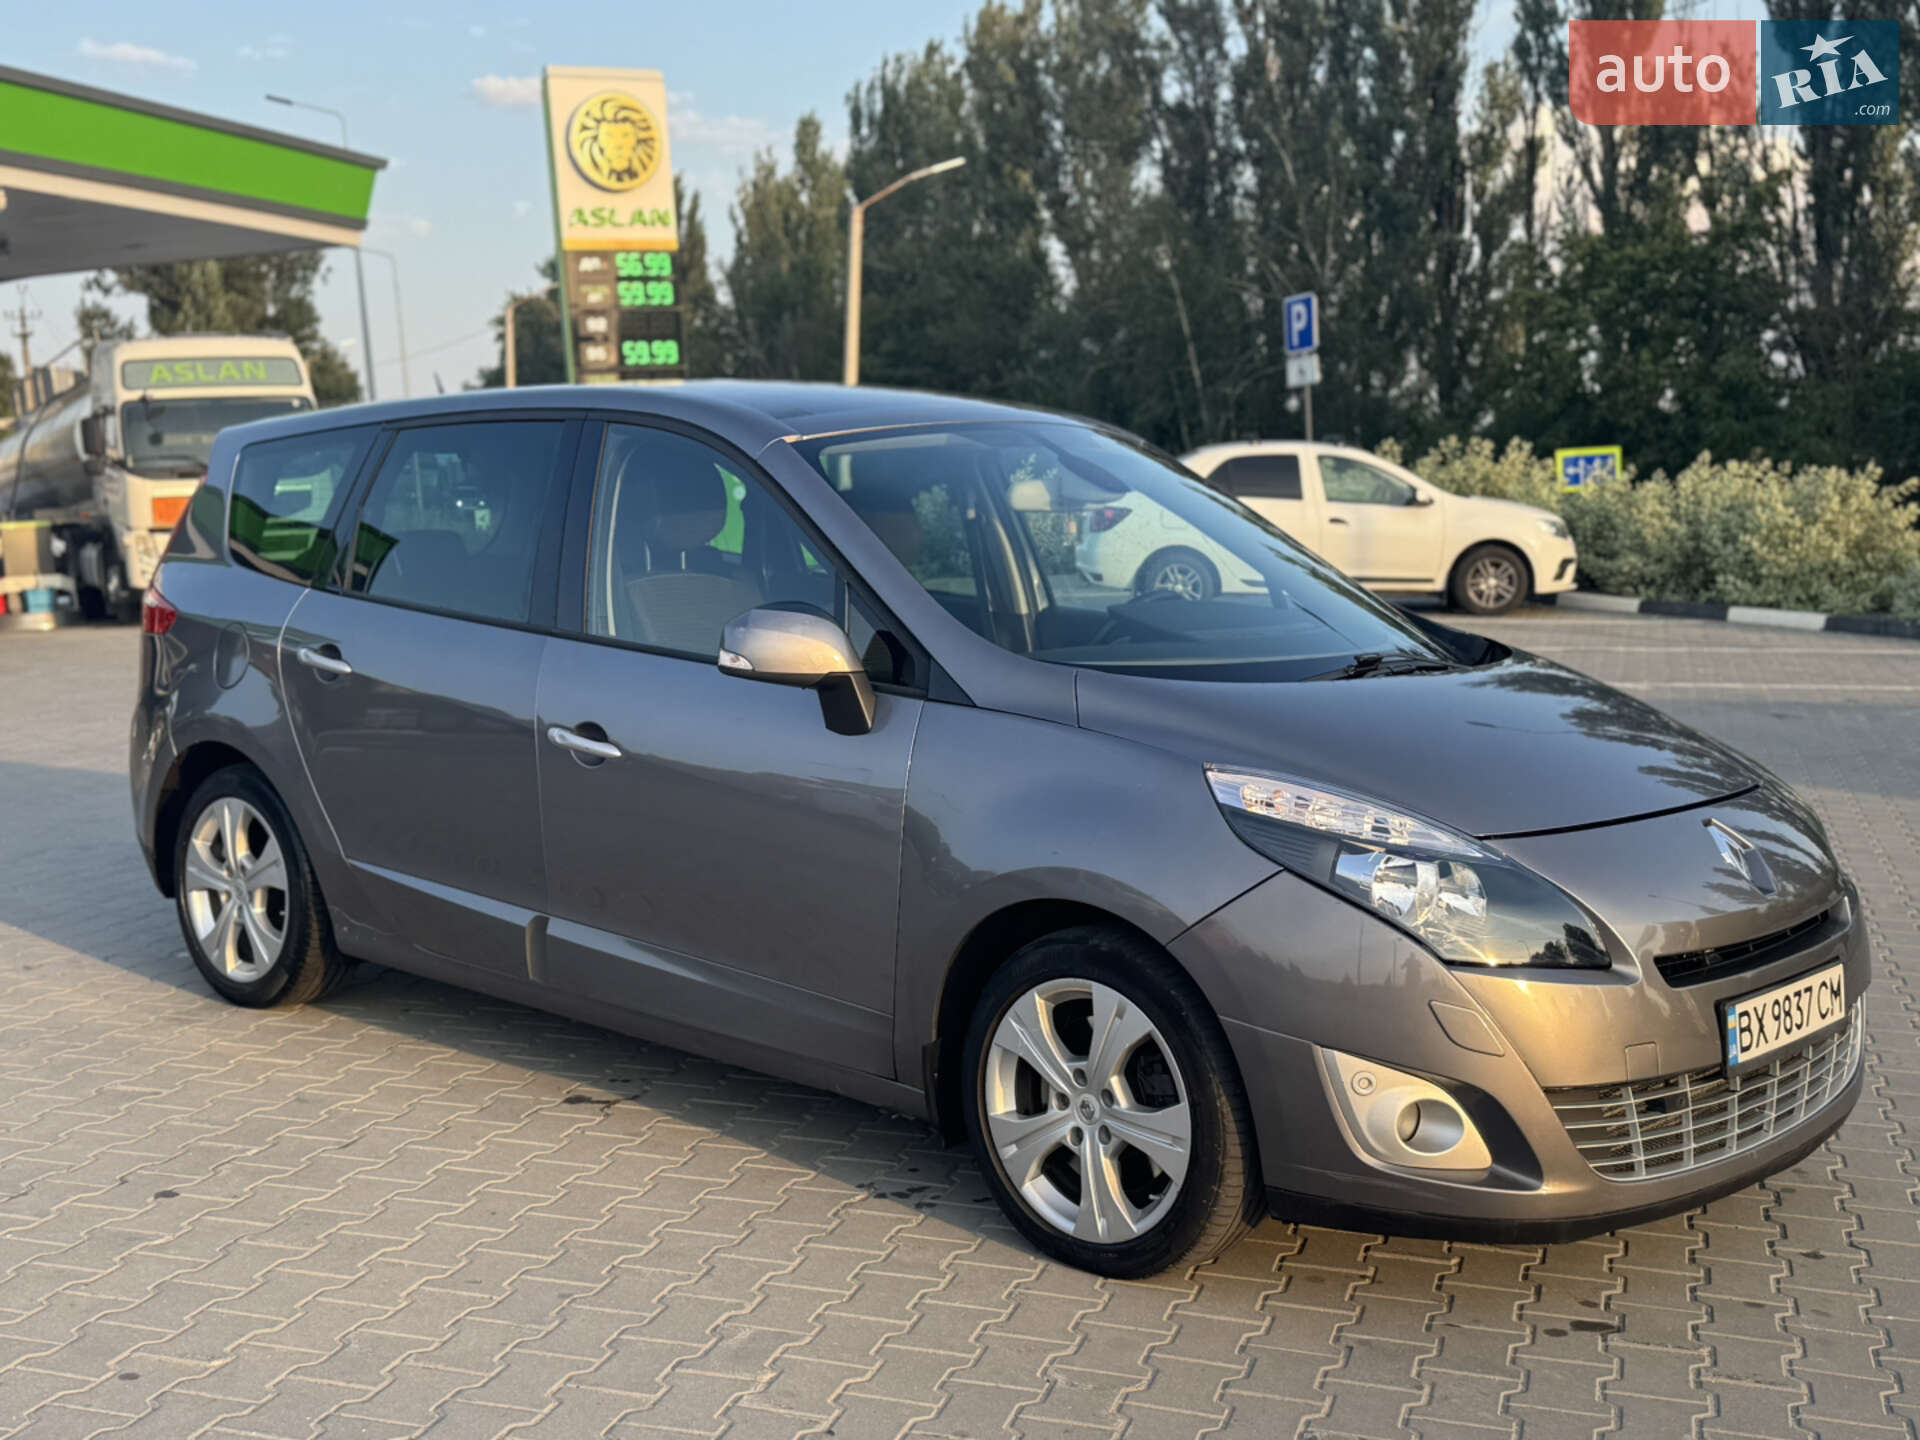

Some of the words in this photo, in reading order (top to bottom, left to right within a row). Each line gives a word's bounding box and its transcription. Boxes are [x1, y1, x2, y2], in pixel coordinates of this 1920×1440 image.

[569, 206, 672, 228] ASLAN
[1291, 302, 1309, 347] P
[150, 360, 267, 384] ASLAN
[1738, 1003, 1769, 1055] BX
[1771, 985, 1813, 1041] 9837
[1816, 973, 1843, 1020] CM
